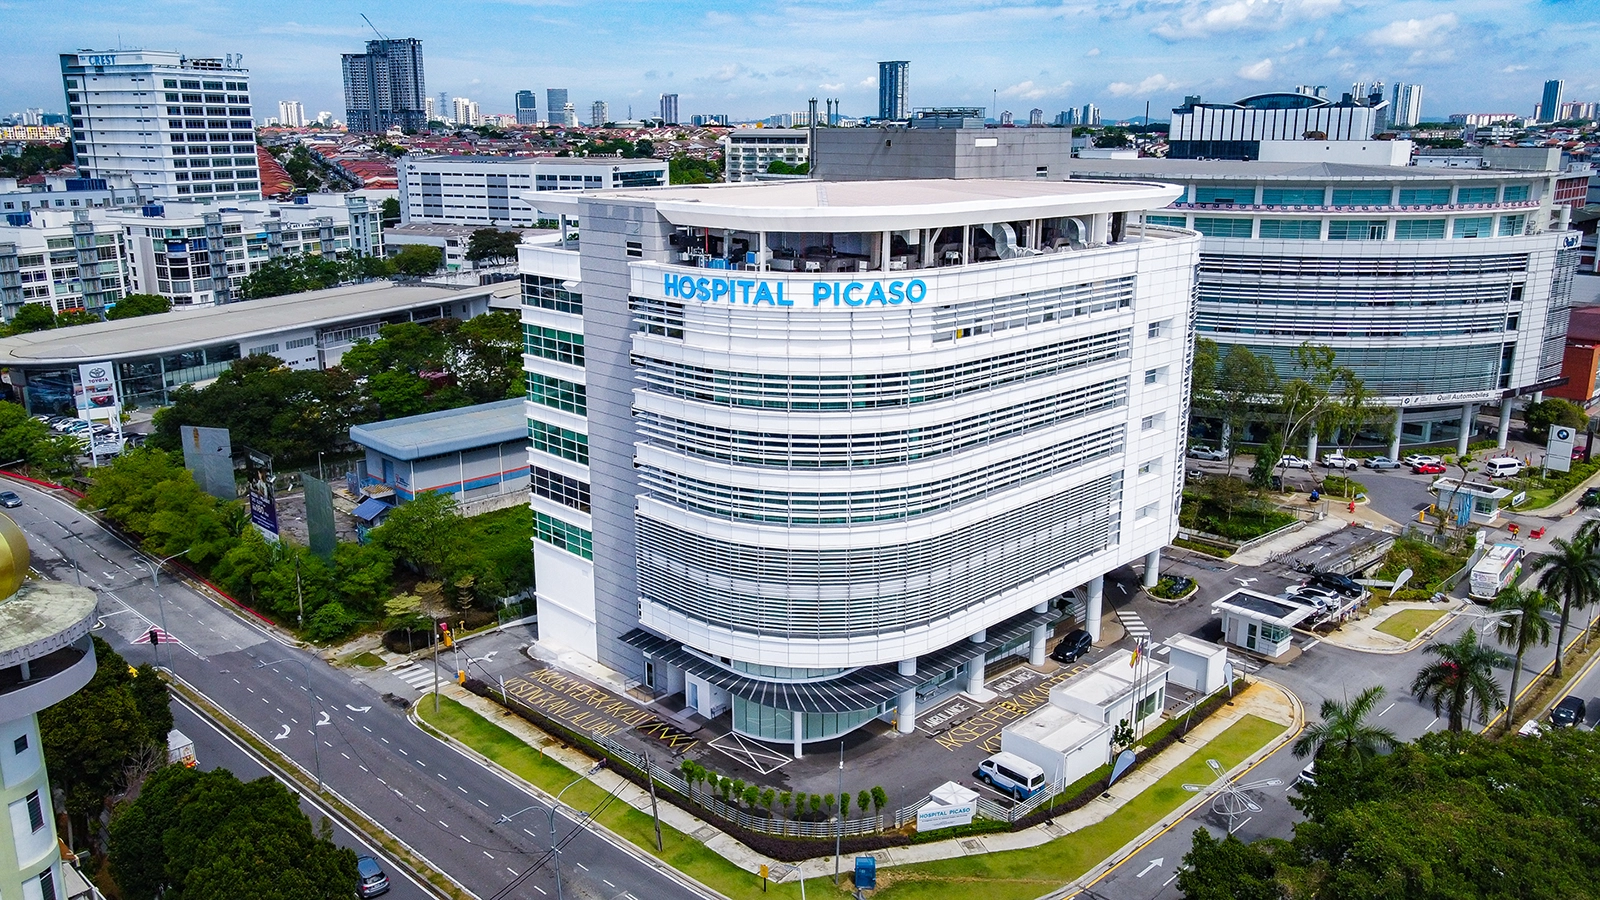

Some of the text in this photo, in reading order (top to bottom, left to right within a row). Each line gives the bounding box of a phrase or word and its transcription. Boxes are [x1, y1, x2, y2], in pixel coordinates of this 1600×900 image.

[89, 55, 116, 66] CREST
[664, 273, 927, 307] HOSPITAL PICASO
[1452, 392, 1490, 400] Automobiles
[935, 717, 998, 752] AKSES
[920, 811, 947, 819] HOSPITAL
[949, 807, 971, 815] PICASO
